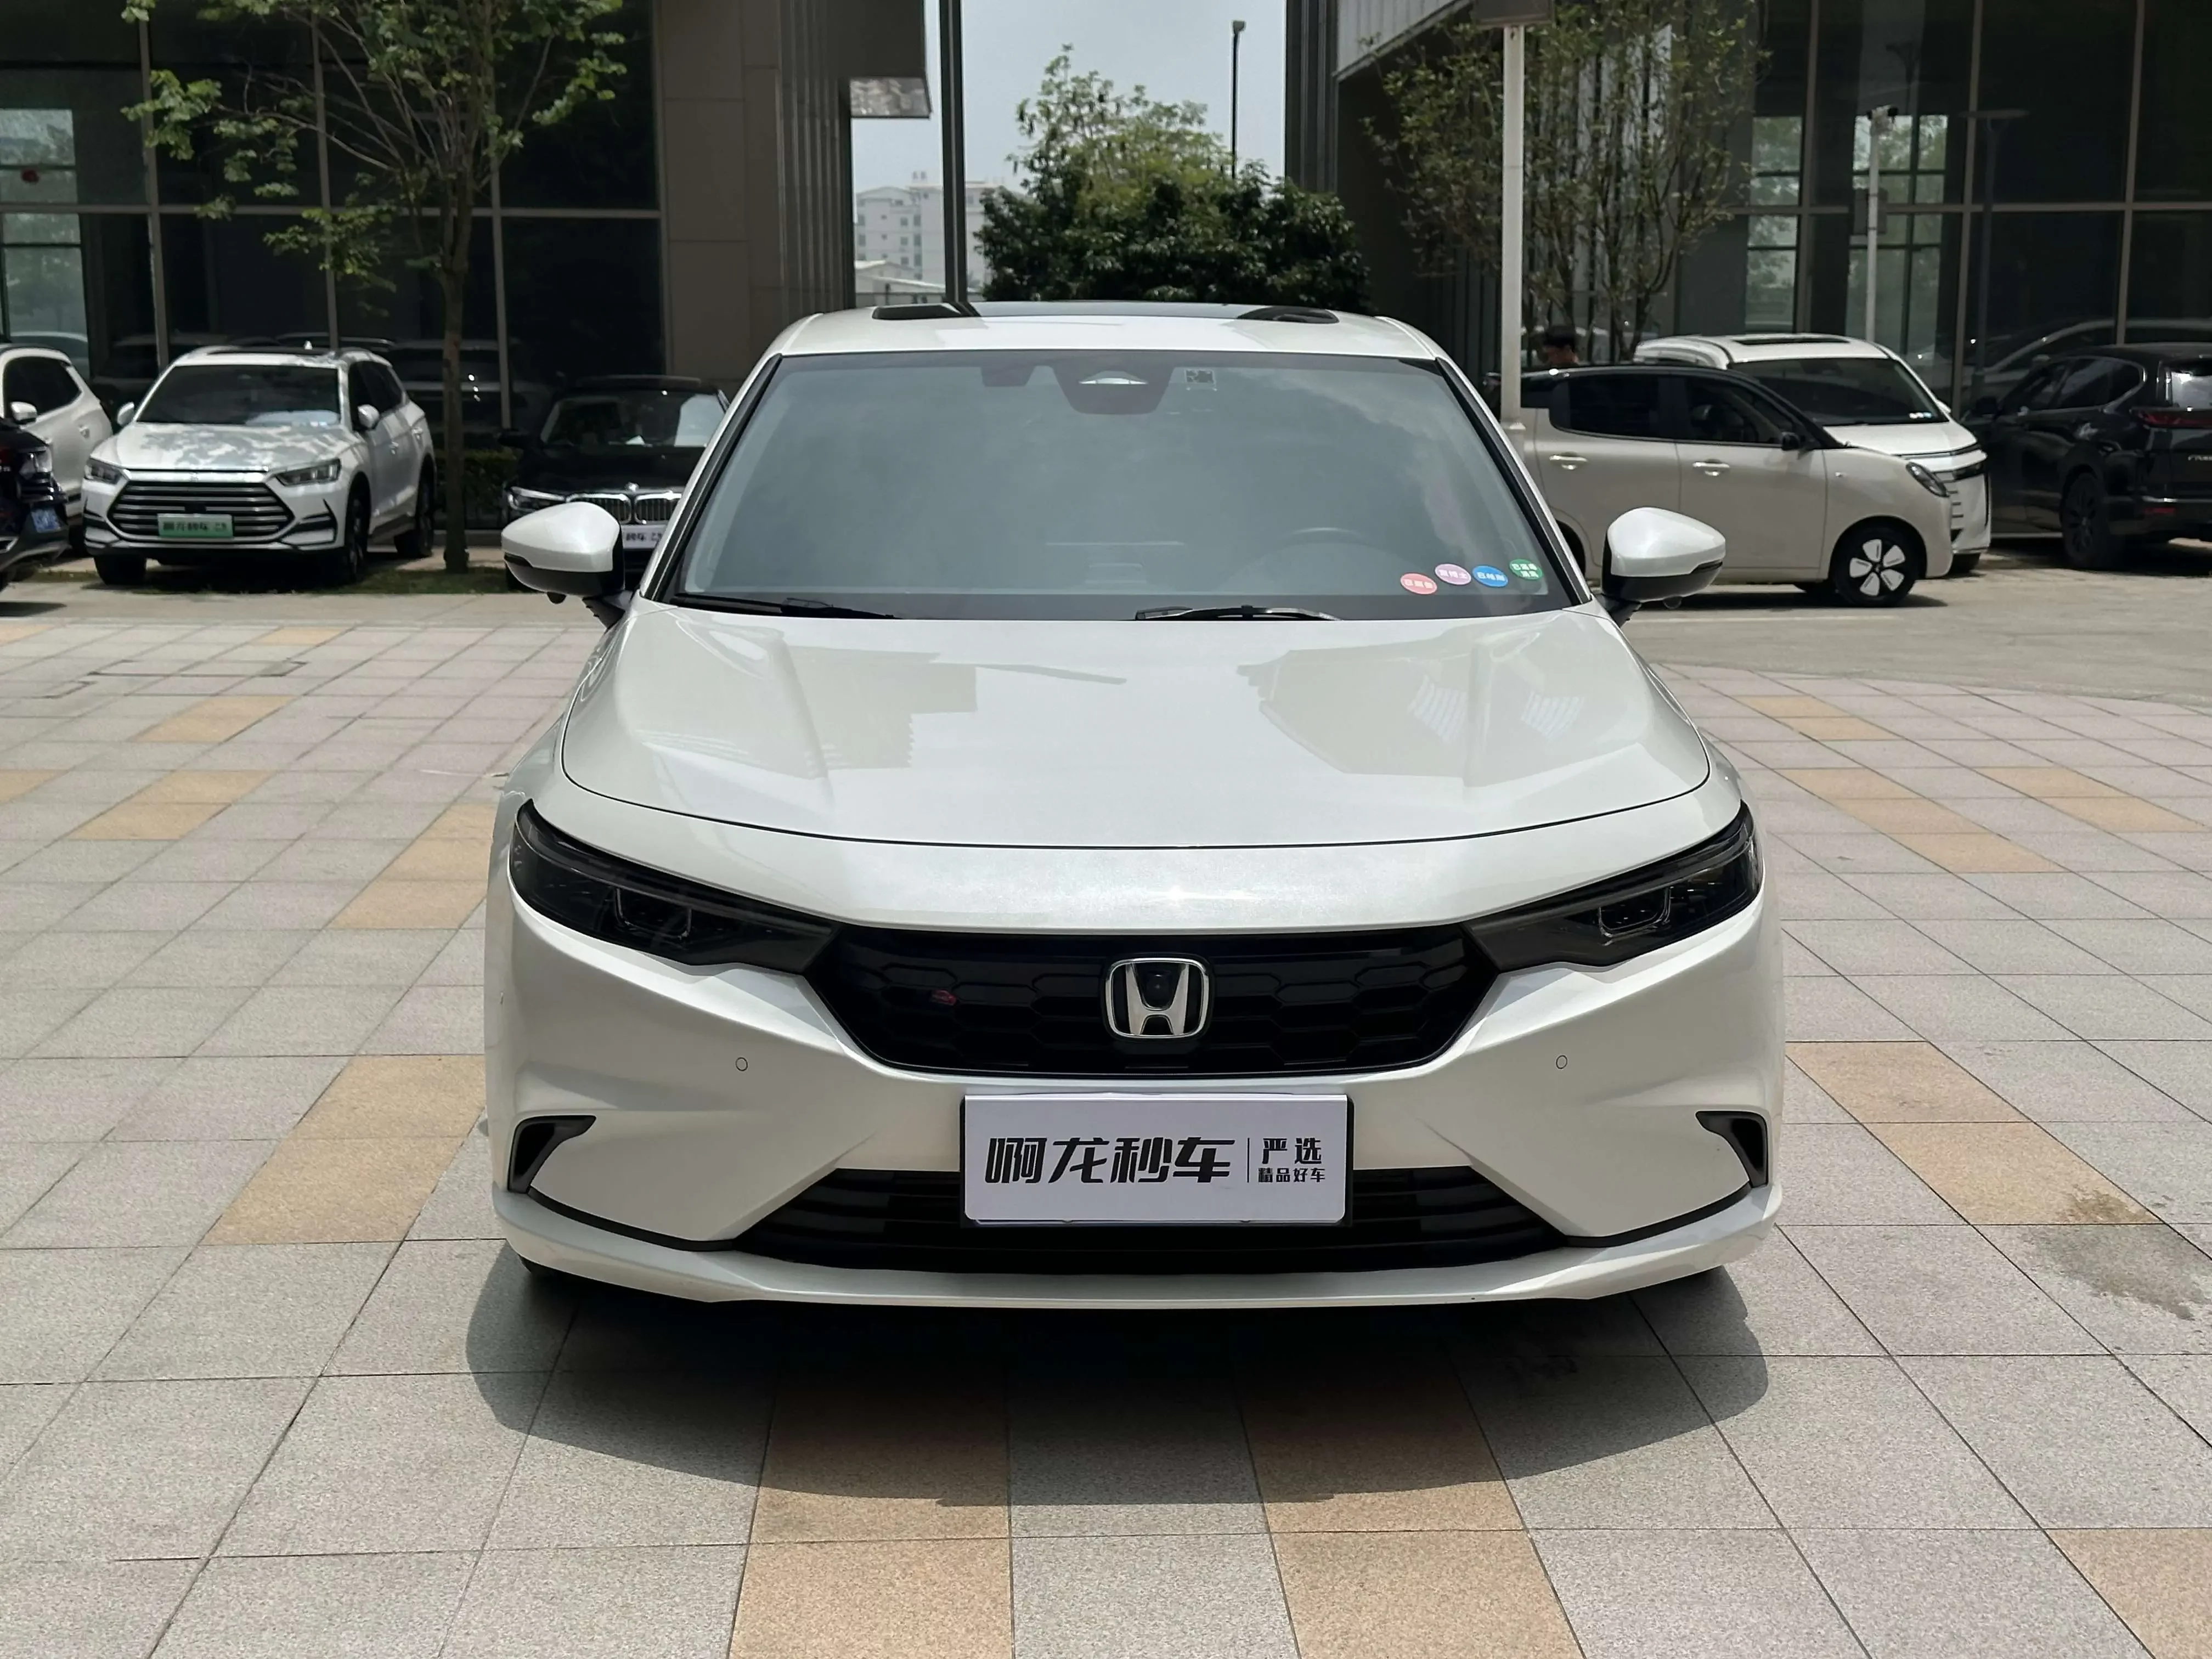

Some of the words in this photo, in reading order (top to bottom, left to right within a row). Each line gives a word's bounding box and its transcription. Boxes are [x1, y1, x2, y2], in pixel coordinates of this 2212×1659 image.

[984, 1137, 1235, 1183] 啊龙秒车
[1262, 1137, 1322, 1164] 严选
[1258, 1167, 1325, 1183] 精品好车
